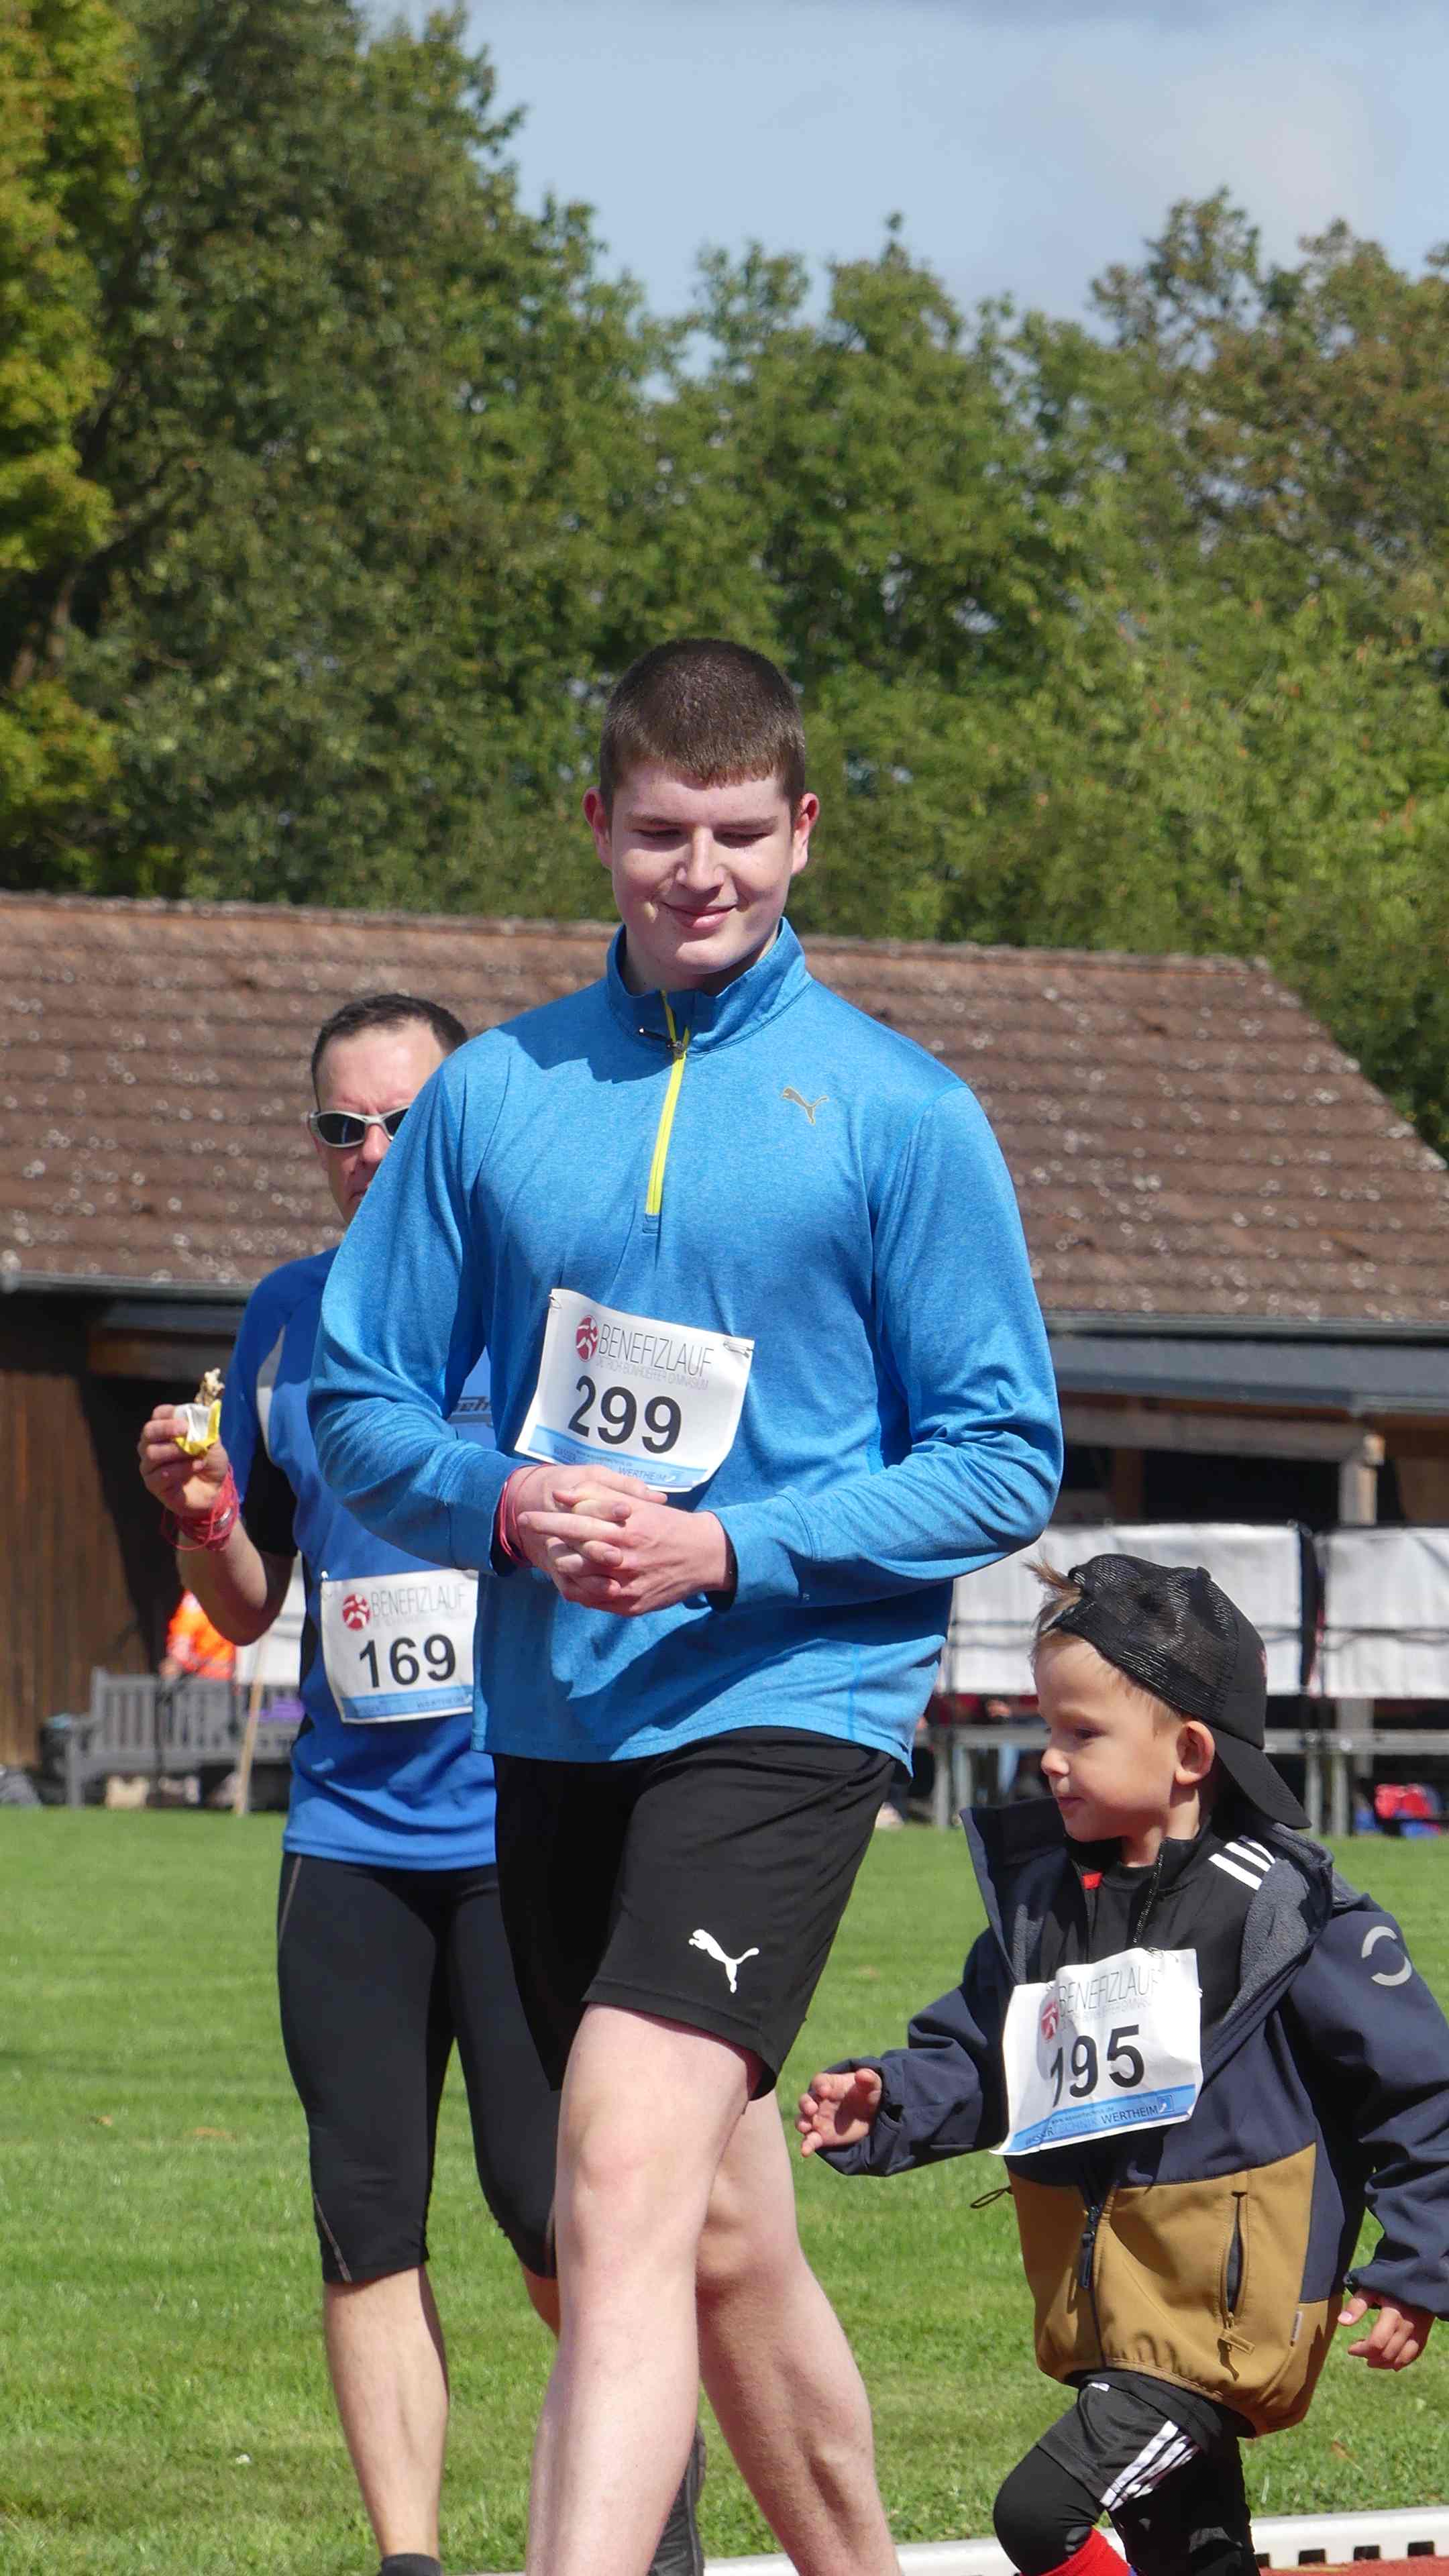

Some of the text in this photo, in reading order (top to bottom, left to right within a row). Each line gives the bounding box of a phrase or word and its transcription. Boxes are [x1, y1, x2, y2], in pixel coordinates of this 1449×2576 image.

[598, 1324, 714, 1377] BENEFIZLAUF
[568, 1375, 682, 1454] 299
[370, 1583, 466, 1617] BENEFIZLAUF
[360, 1633, 456, 1688] 169
[1058, 1966, 1161, 2017] BENEFIZLAUF
[1050, 2024, 1144, 2108] 195
[1101, 2105, 1159, 2125] WERTHEIM
